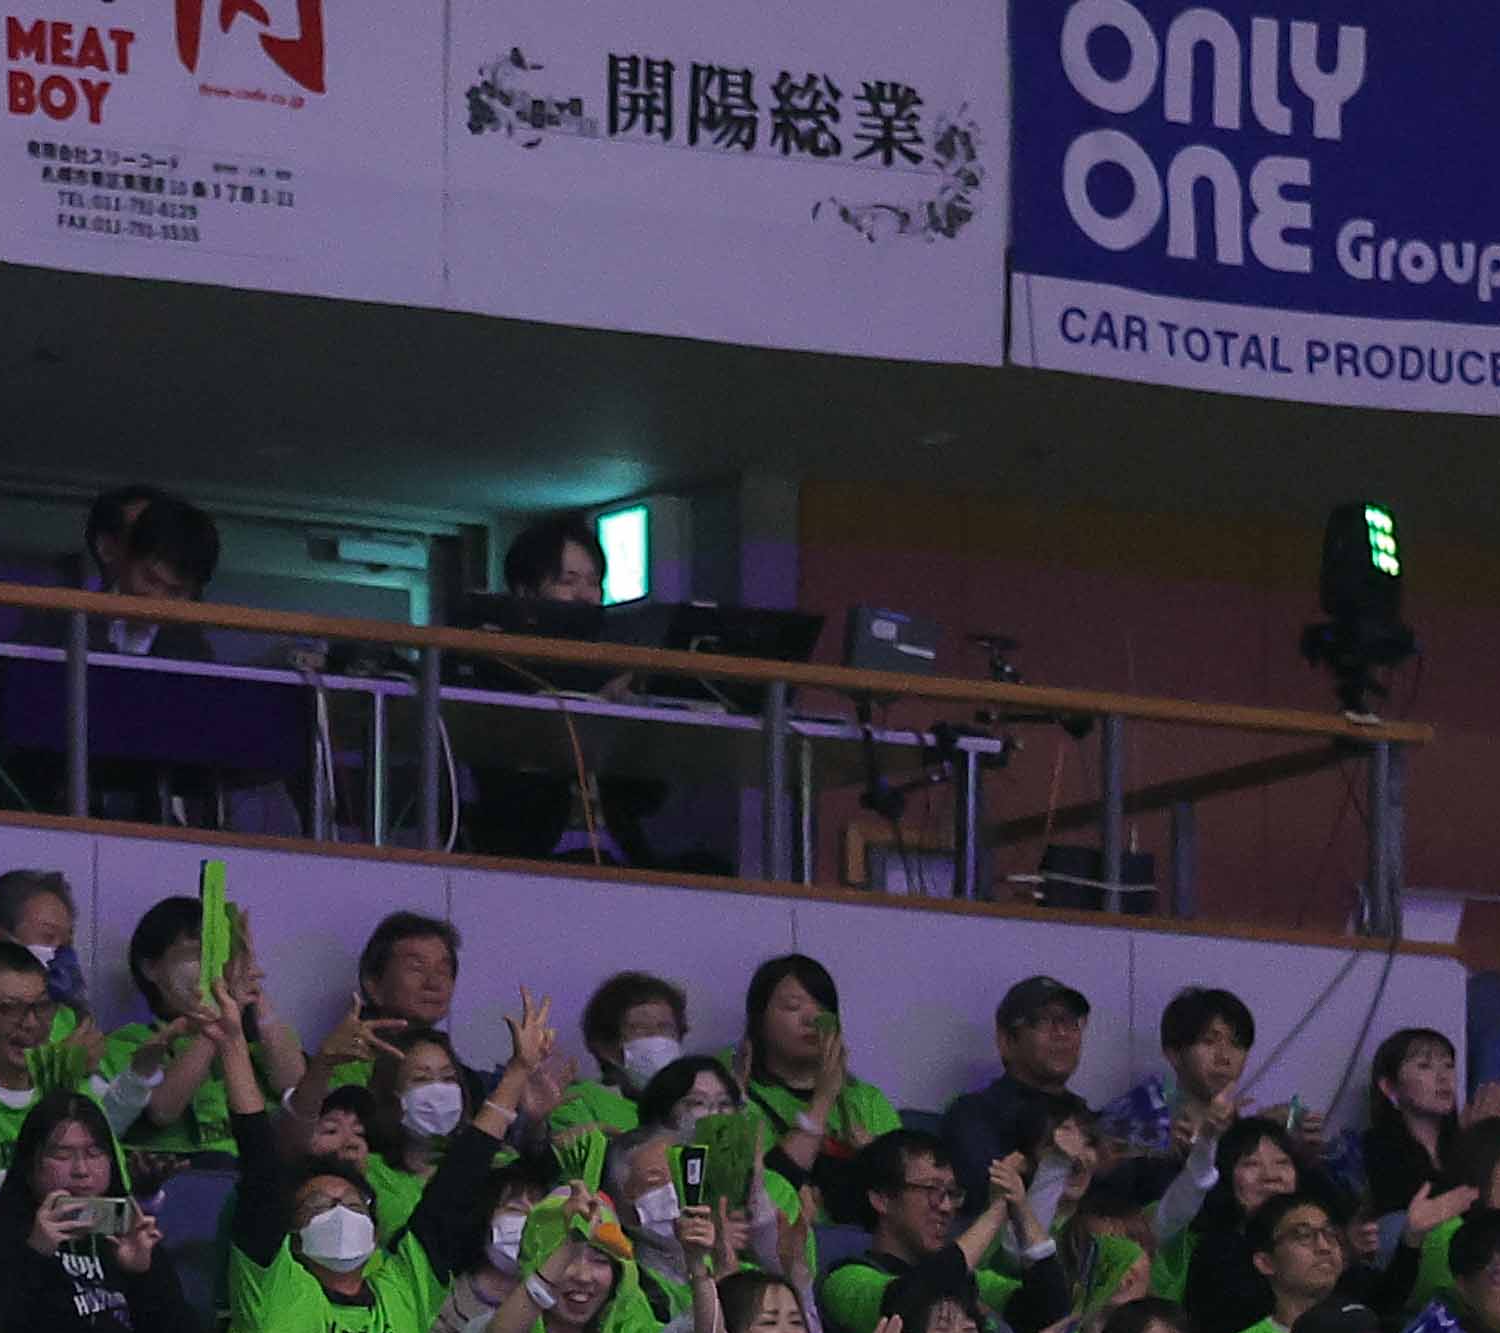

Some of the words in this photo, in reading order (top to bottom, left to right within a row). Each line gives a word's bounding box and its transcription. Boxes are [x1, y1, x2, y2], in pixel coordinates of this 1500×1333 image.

[6, 16, 135, 75] MEAT
[1061, 0, 1367, 141] ONLY
[7, 70, 111, 125] BOY
[606, 52, 926, 168] 開陽総業
[1063, 128, 1313, 274] ONE
[1061, 306, 1148, 353] CAR
[1157, 320, 1294, 374] TOTAL
